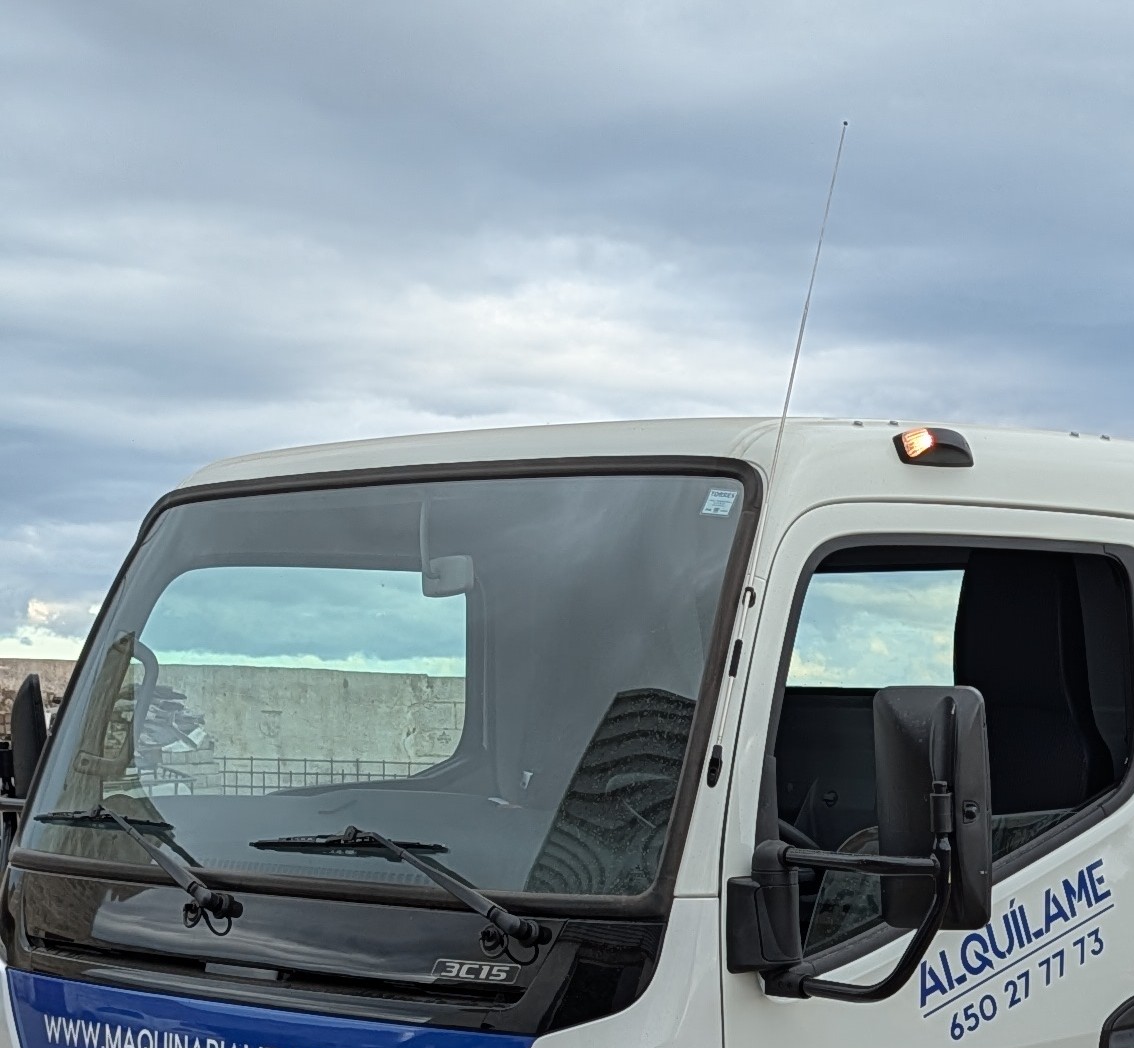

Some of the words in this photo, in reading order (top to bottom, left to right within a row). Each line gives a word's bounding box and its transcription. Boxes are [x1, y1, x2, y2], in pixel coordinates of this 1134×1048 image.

[441, 962, 510, 980] 3C15
[920, 858, 1111, 1008] ALQUÍLAME
[950, 994, 997, 1041] 650
[1004, 969, 1030, 1009] 27
[1038, 948, 1065, 986] 77
[1072, 927, 1104, 965] 73
